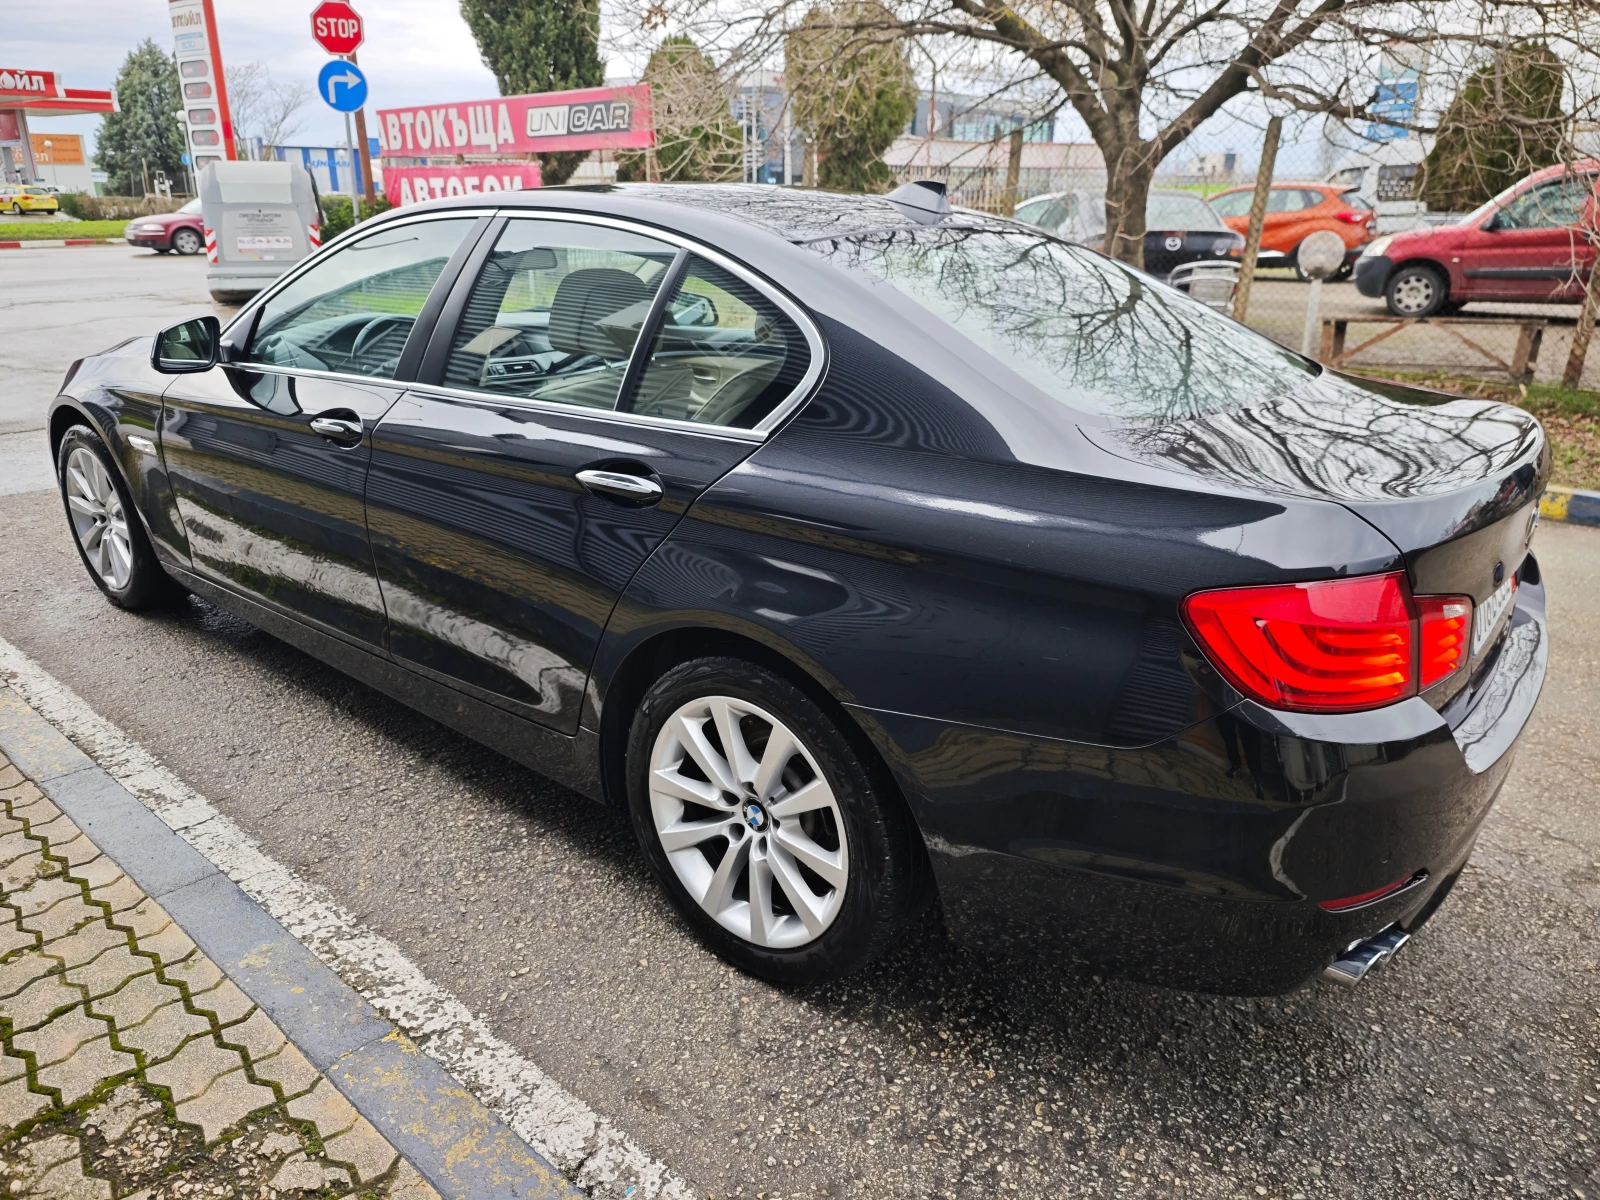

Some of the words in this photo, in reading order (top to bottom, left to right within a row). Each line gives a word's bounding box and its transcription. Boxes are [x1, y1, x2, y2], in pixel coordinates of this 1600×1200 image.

[316, 17, 359, 38] STOP
[0, 70, 45, 92] ОЙЛ
[377, 103, 515, 151] АВТОКЪЩА
